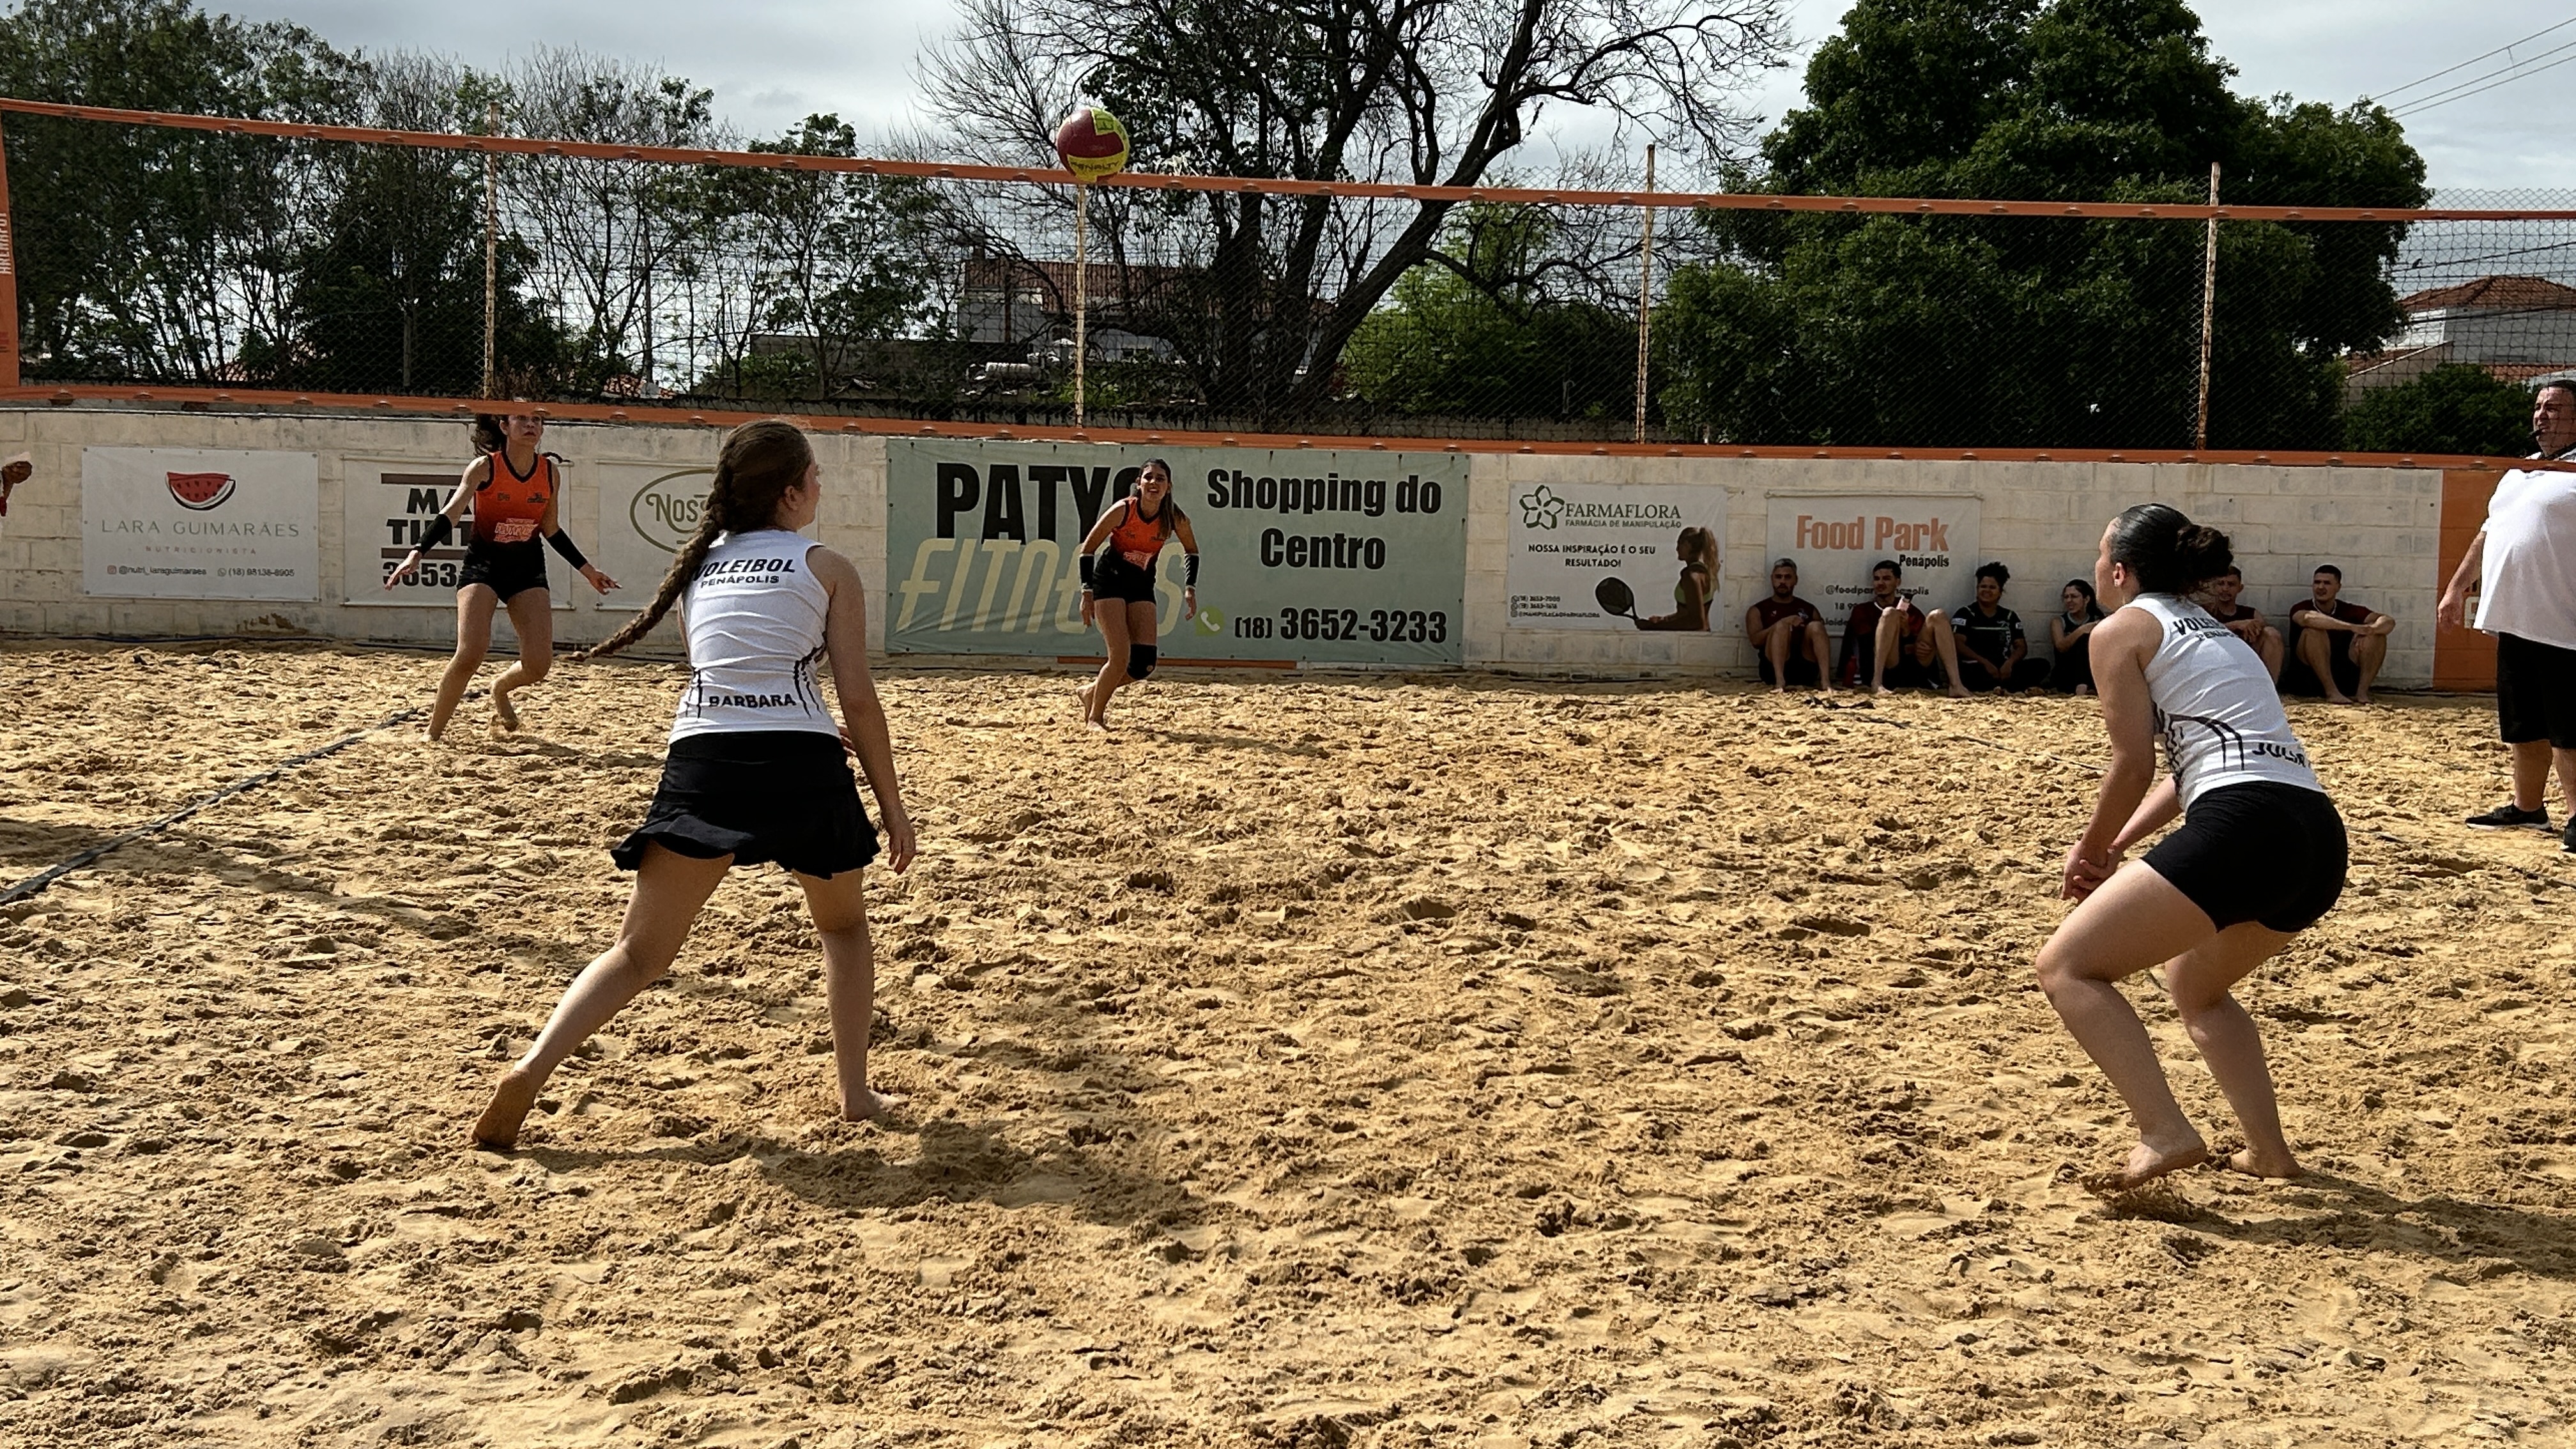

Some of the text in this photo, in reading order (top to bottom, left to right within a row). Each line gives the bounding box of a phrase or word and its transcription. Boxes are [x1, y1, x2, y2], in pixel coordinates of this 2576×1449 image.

[1207, 469, 1441, 517] Shopping do
[1565, 503, 1682, 519] FARMAFLORA
[102, 520, 299, 537] LARA GUIMARÃES
[1565, 519, 1607, 528] FARMÁCIA
[1622, 519, 1682, 529] MANIPULAÇÃO
[1796, 515, 1949, 551] Food Park
[1261, 528, 1386, 569] Centro
[1528, 544, 1656, 556] NOSSA INSPIRAÇÃO É O SEU
[693, 558, 795, 581] VOLEIBOL
[1565, 558, 1621, 567] RESULTADO!
[1899, 554, 1949, 569] Penápolis
[701, 575, 779, 588] PENÁPOLIS
[1234, 608, 1447, 643] (18) 3652-3233
[708, 693, 797, 709] BARBARA
